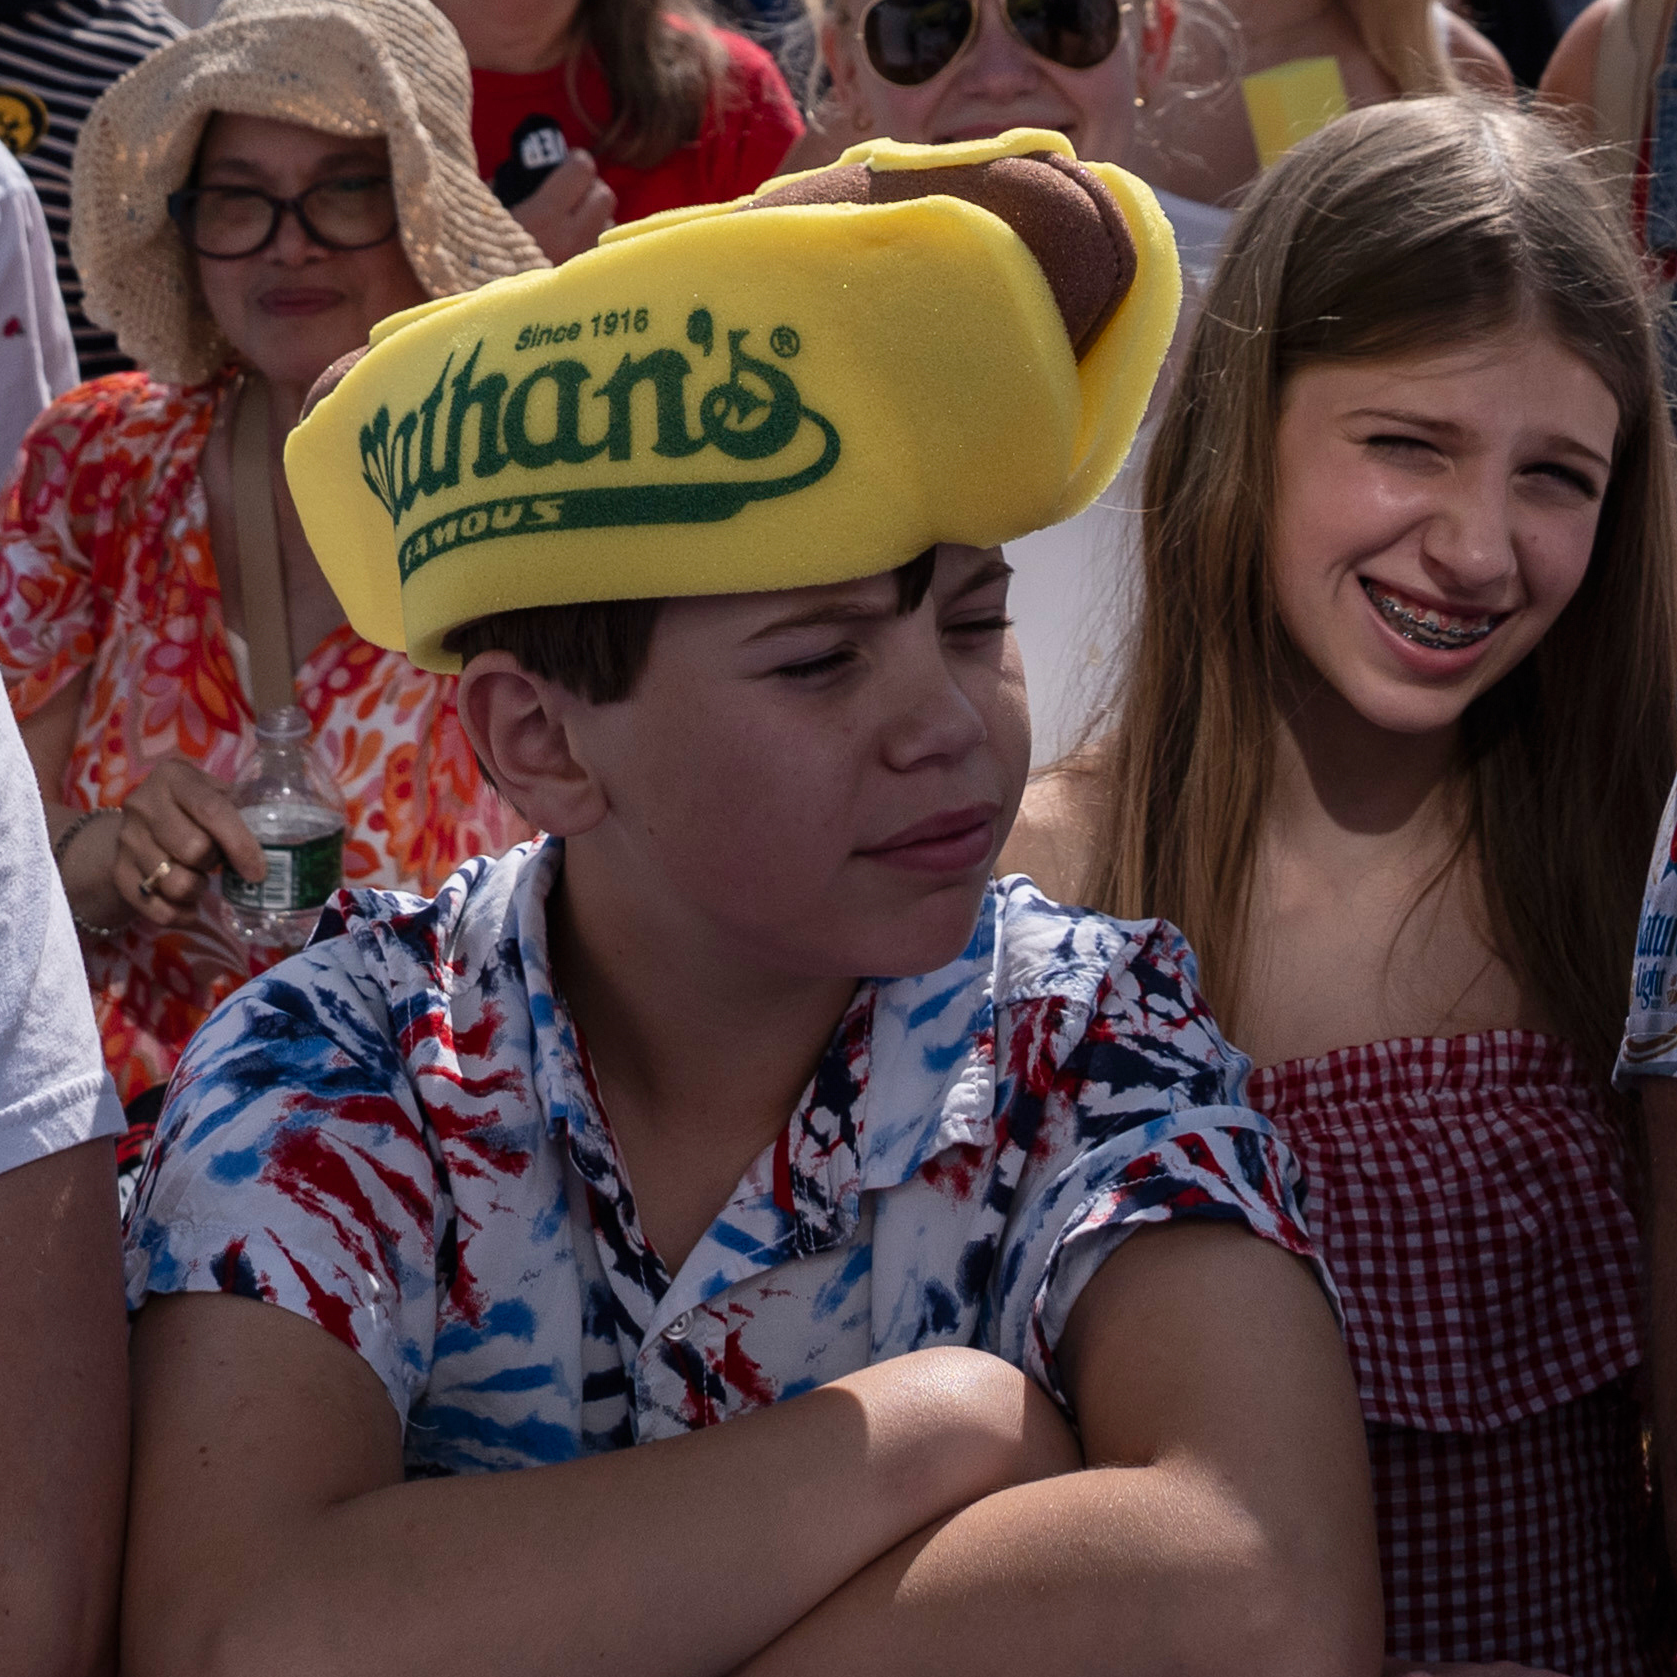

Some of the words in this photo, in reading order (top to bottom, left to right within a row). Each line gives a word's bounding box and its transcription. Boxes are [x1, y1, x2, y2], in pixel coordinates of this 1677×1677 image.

[515, 321, 581, 351] Since
[591, 308, 650, 338] 1916
[359, 307, 801, 527] Nathan's
[404, 498, 566, 570] FAMOUS
